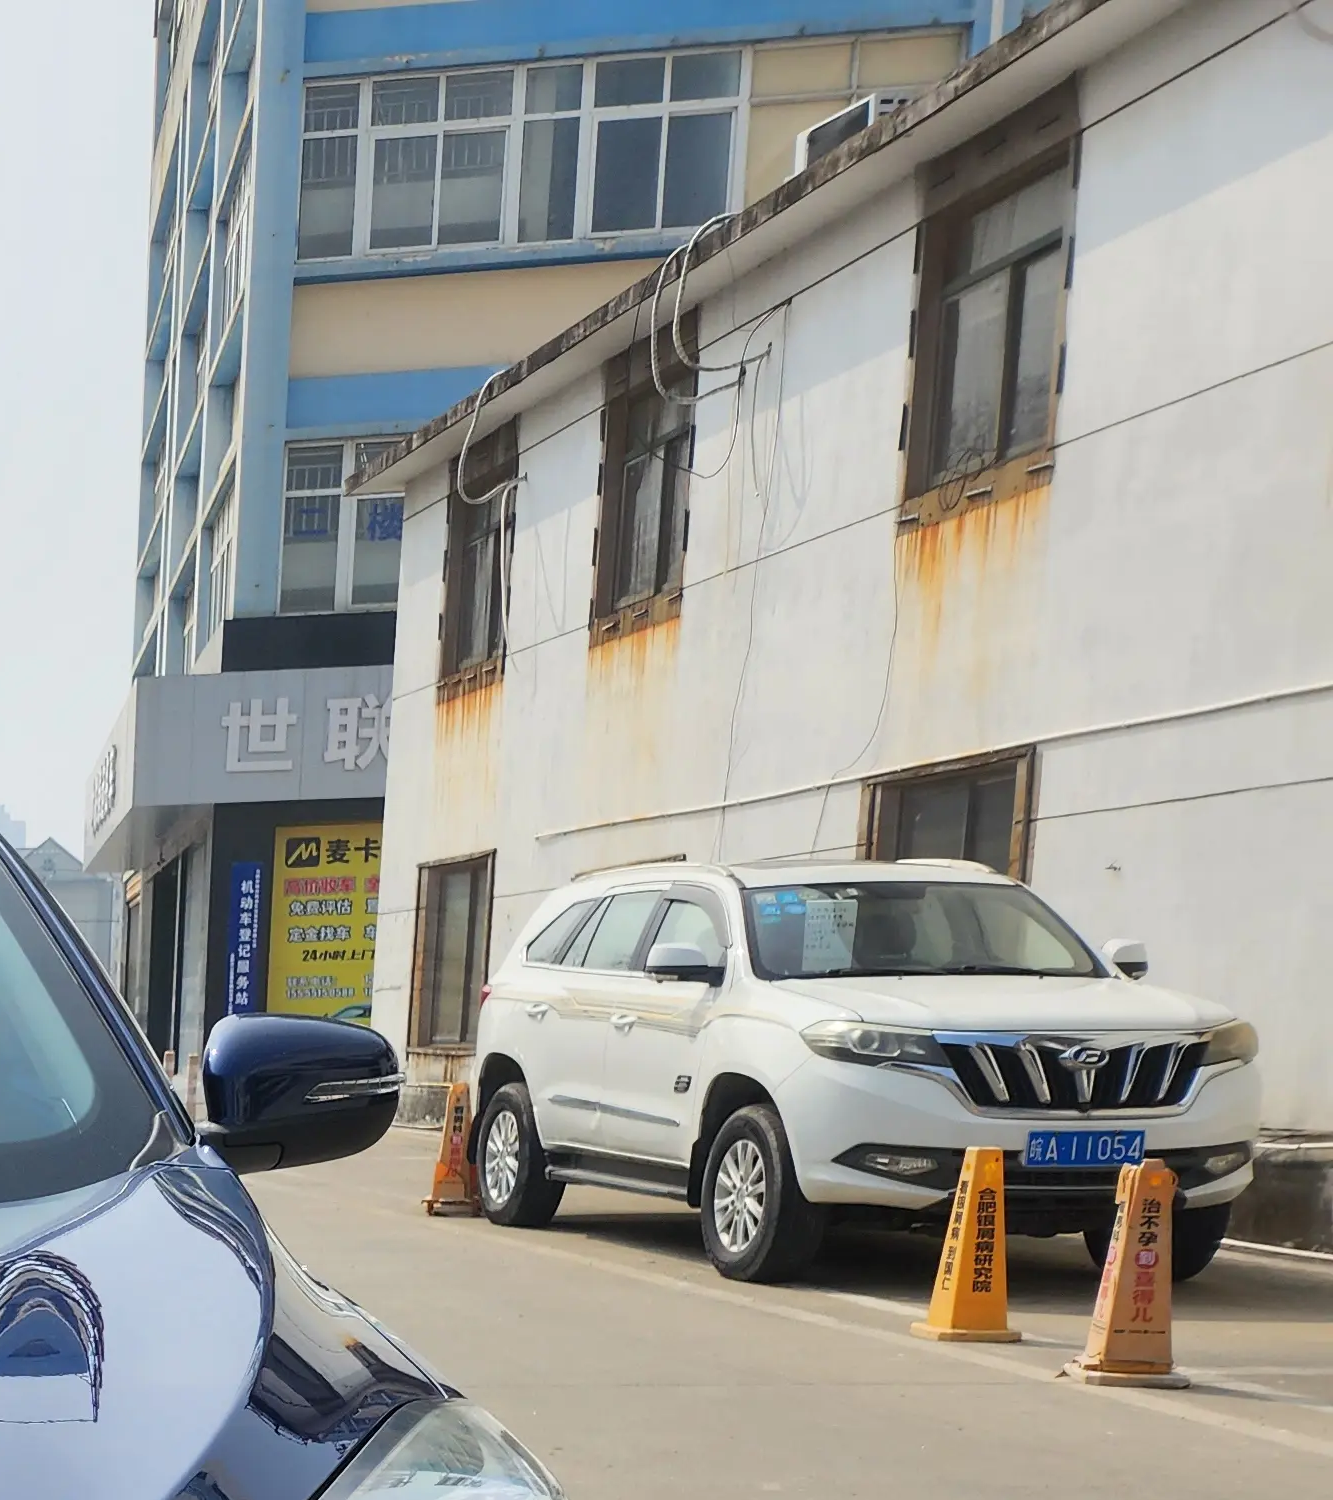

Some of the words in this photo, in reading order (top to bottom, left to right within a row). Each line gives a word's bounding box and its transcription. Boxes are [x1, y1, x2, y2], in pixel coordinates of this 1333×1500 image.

[326, 838, 381, 864] 麦卡
[235, 879, 254, 1006] 机动车登记服务站
[972, 1187, 997, 1293] 合肥银屑病研究院
